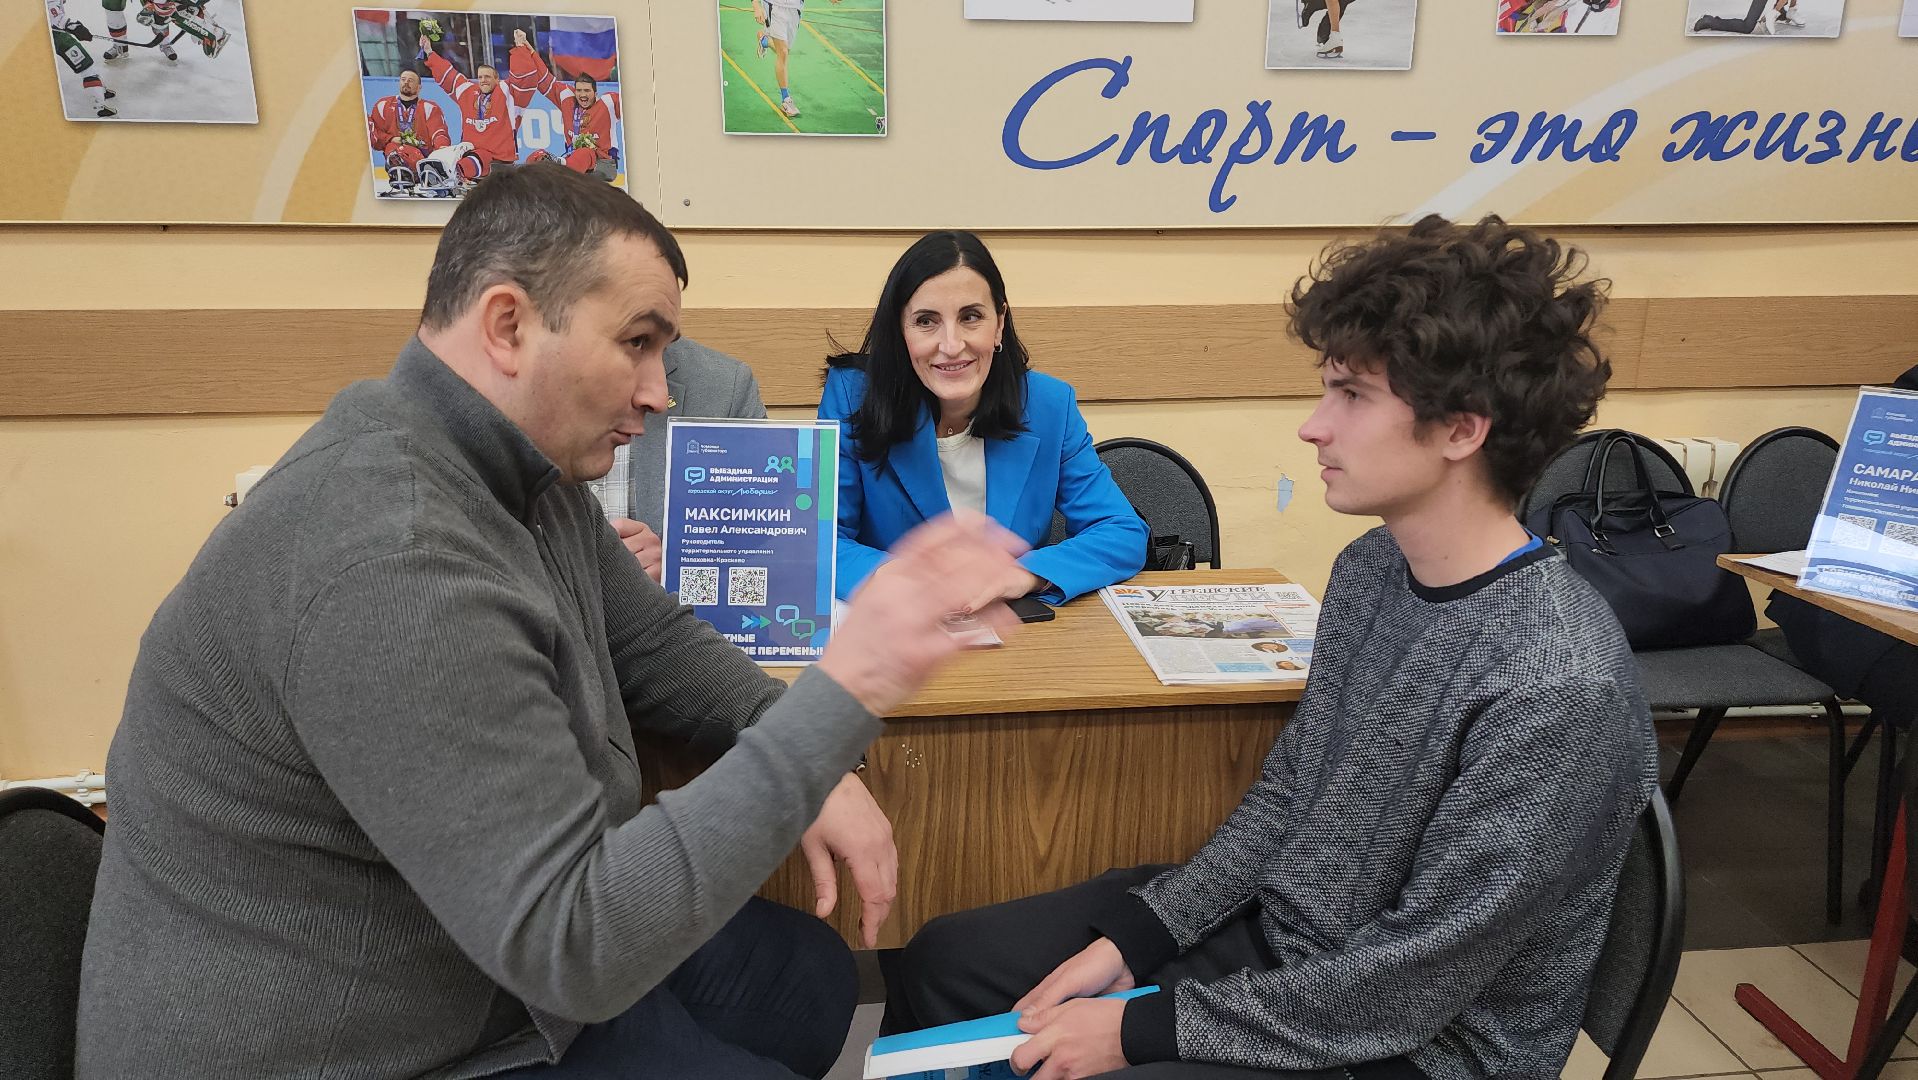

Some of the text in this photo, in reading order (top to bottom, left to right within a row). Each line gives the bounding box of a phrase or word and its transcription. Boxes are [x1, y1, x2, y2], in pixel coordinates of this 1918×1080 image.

[1002, 56, 1358, 213] Спорт
[1470, 109, 1637, 165] это
[709, 467, 753, 476] ВЫЕЗДНАЯ
[709, 475, 779, 483] АДМИНИСТРАЦИЯ
[1848, 477, 1898, 492] Николай
[685, 507, 791, 522] МАКСИМКИН
[684, 524, 807, 536] Павел Александрович
